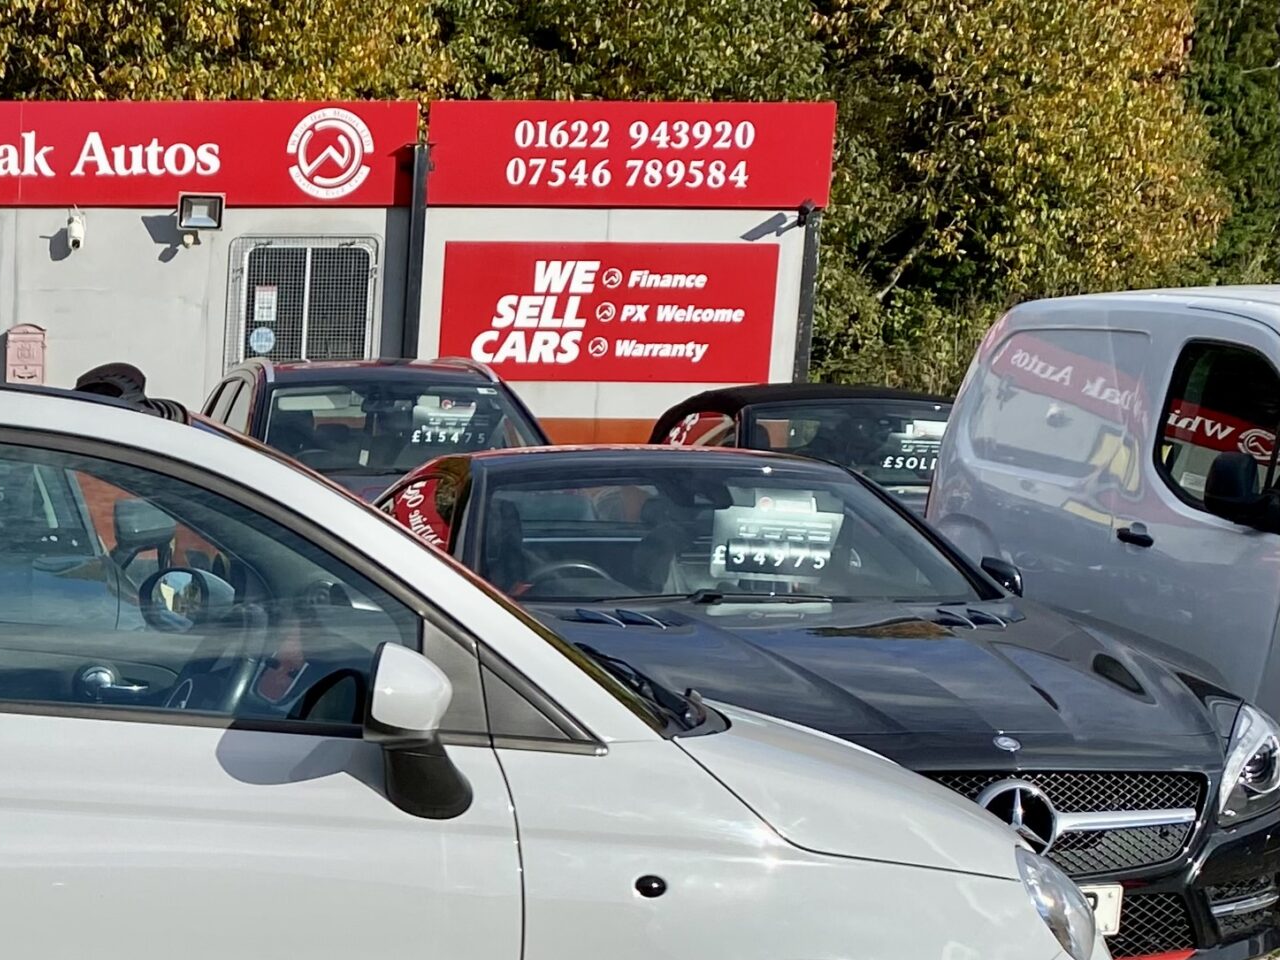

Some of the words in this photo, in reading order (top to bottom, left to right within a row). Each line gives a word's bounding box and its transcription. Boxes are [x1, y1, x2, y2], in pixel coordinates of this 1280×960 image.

[514, 120, 610, 149] 01622
[629, 121, 755, 149] 943920
[71, 131, 221, 176] Autos
[506, 158, 611, 187] 07546
[626, 159, 749, 189] 789584
[533, 260, 601, 293] WE
[627, 270, 708, 288] Finance
[491, 295, 587, 329] SELL
[620, 305, 650, 323] PX
[656, 305, 745, 323] Welcome
[470, 331, 583, 364] CARS
[615, 339, 709, 362] Warranty
[411, 429, 486, 444] £15475
[712, 545, 825, 569] £34975
